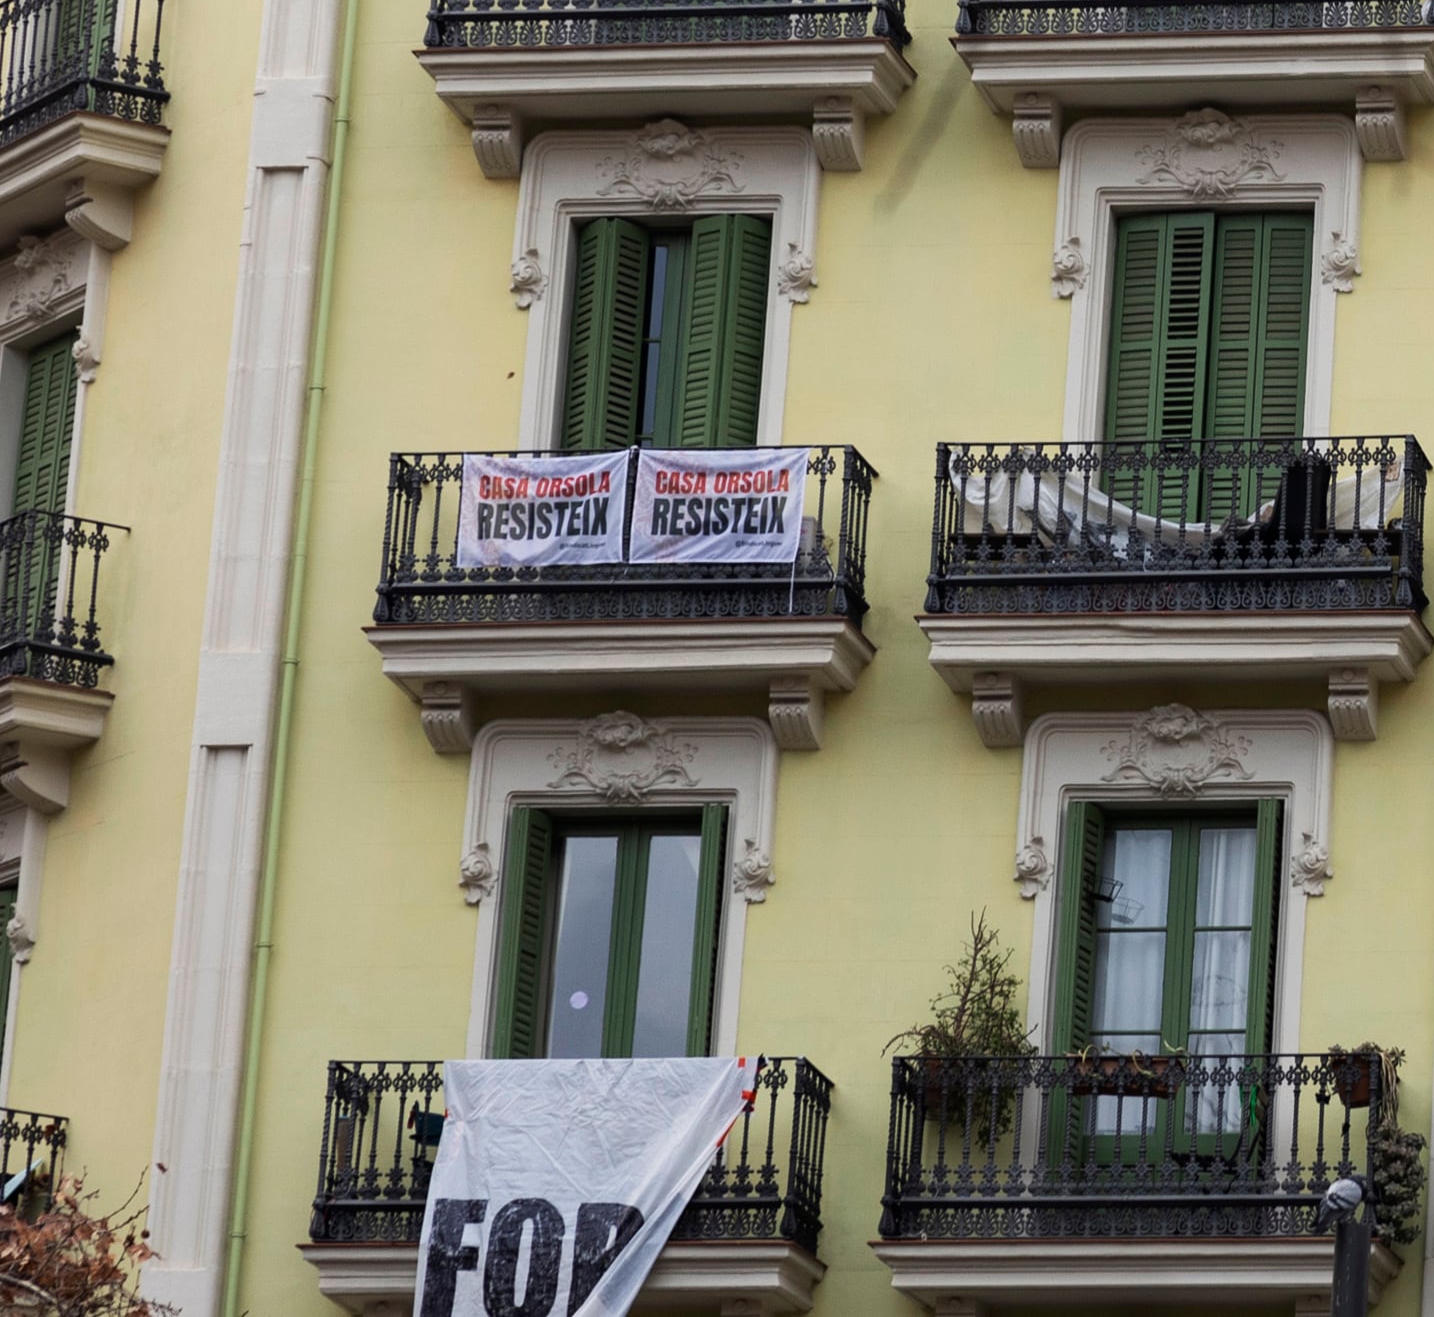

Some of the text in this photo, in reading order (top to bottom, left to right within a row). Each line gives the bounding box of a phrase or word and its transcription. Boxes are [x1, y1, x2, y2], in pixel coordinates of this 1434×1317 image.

[479, 471, 611, 500] CASA ORSOLA
[655, 469, 790, 495] CASA ORSOLA
[478, 497, 609, 540] RESISTEIX
[651, 496, 787, 536] RESISTEIX
